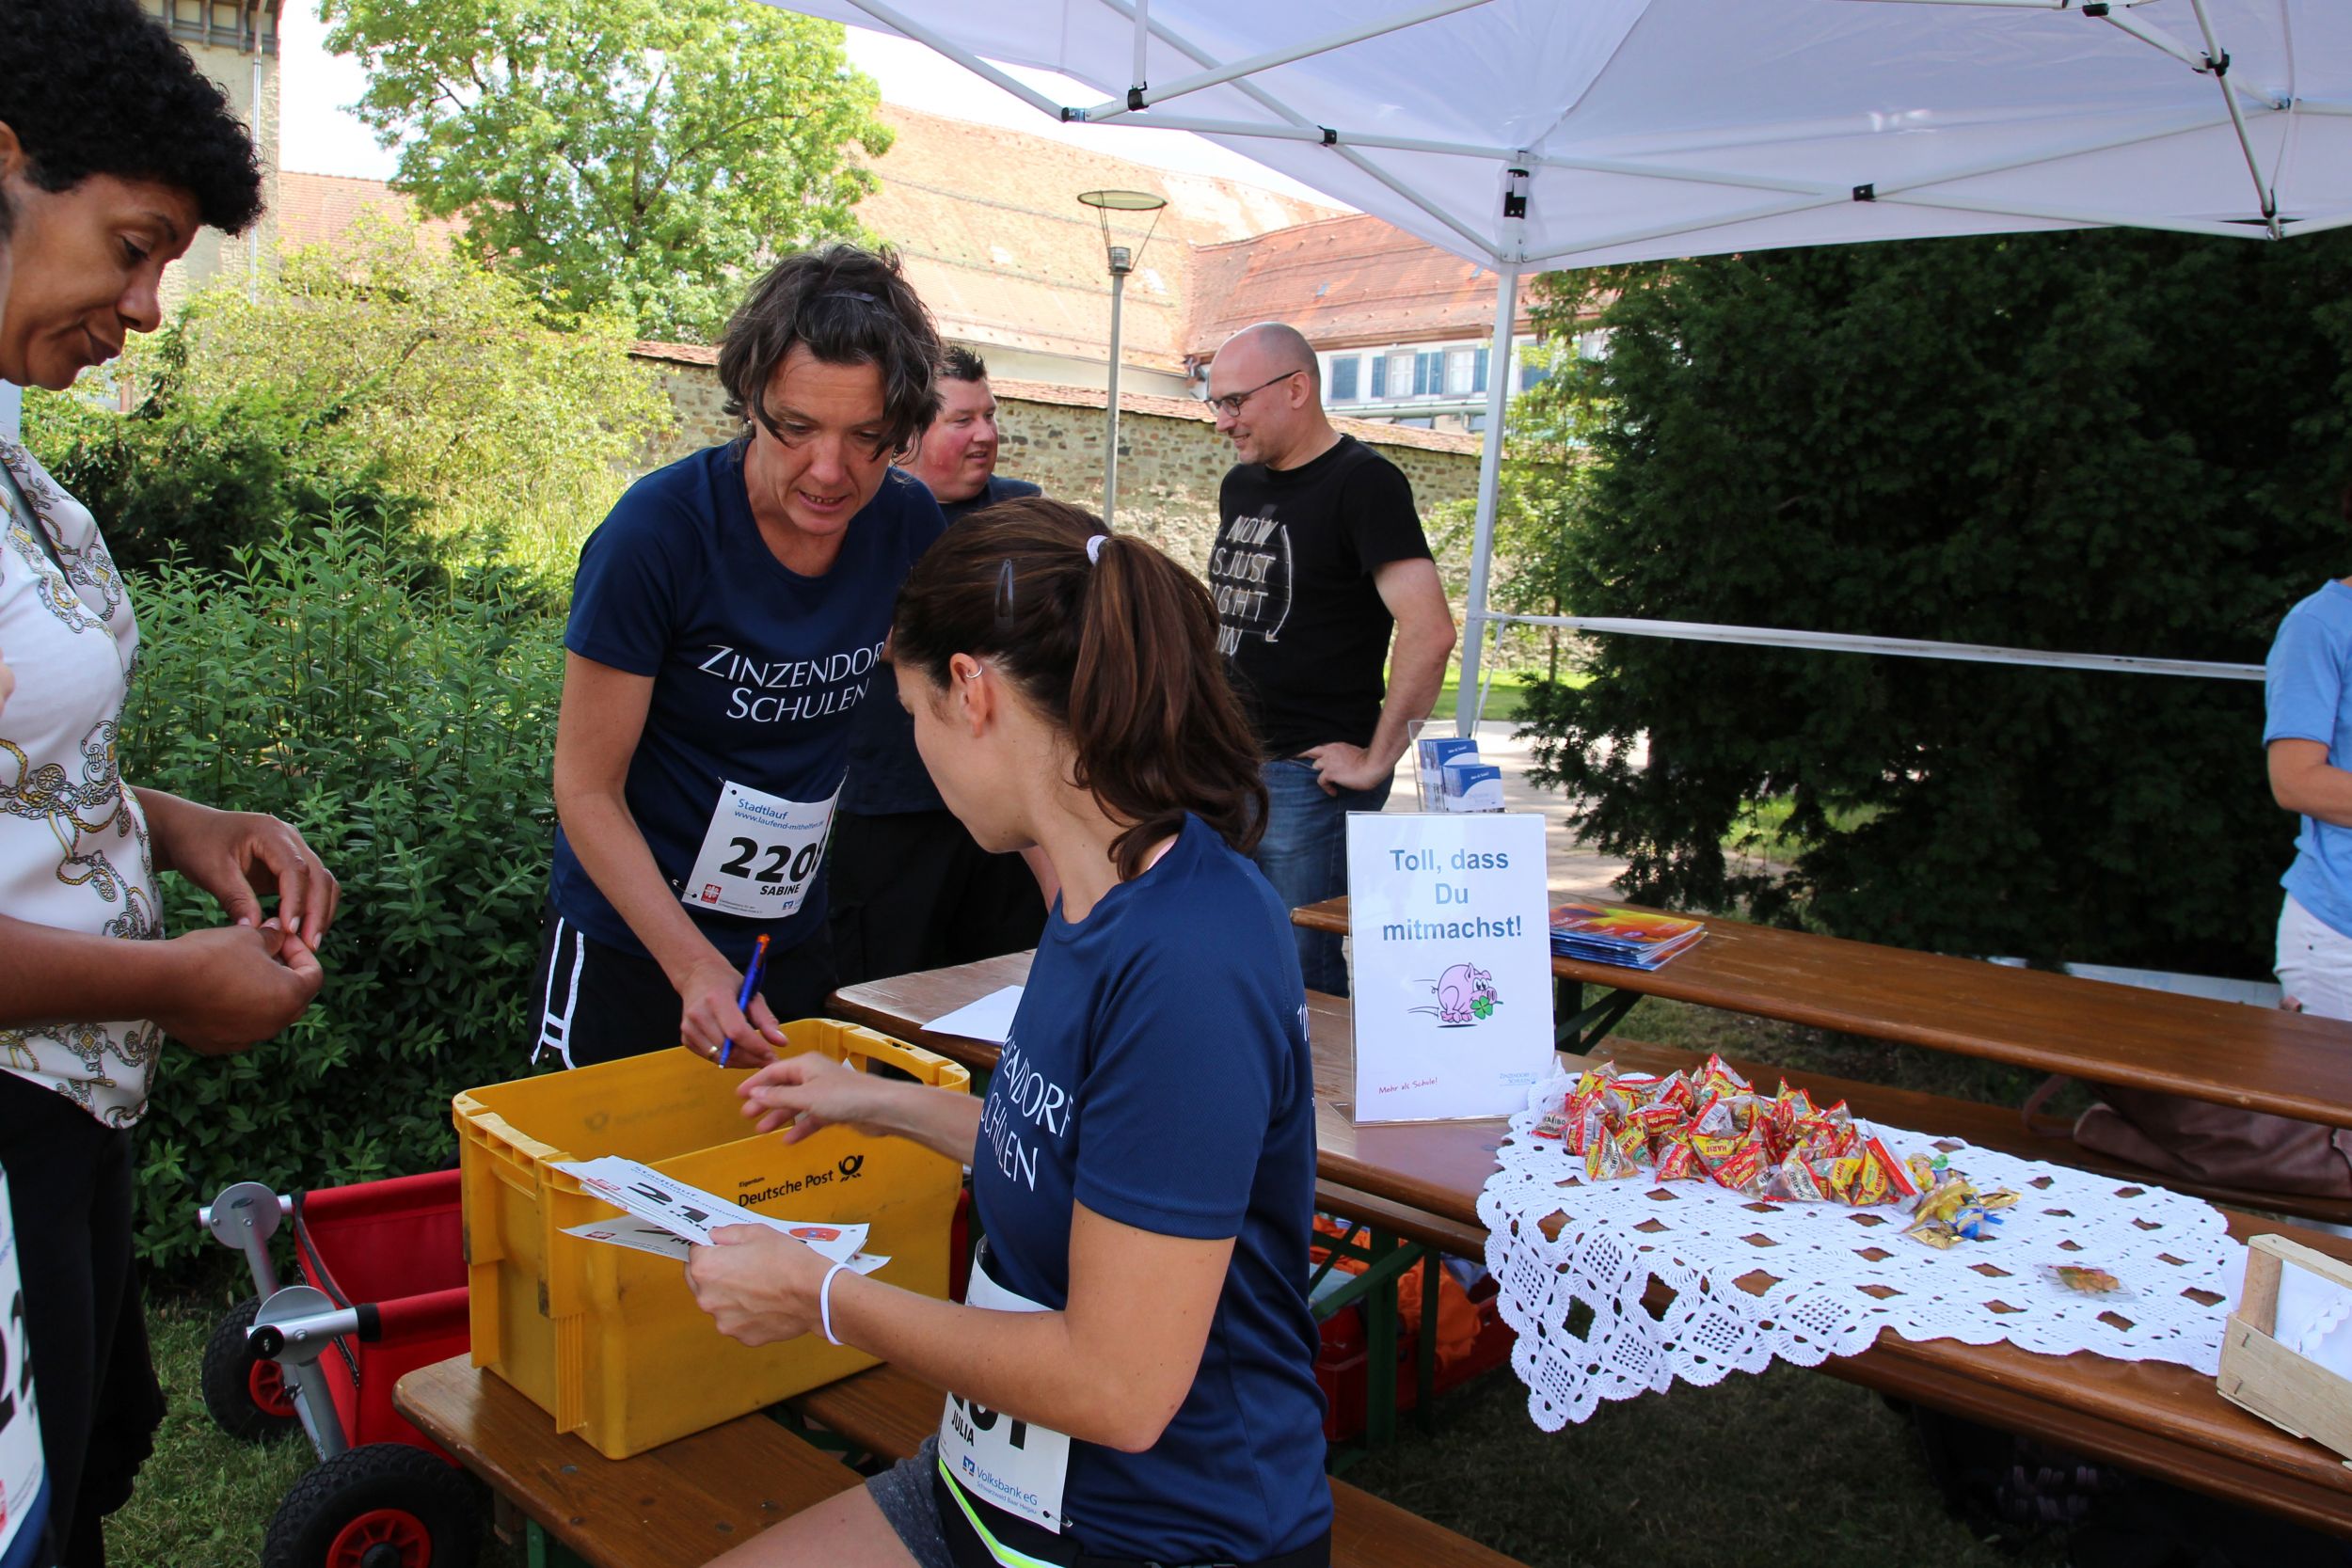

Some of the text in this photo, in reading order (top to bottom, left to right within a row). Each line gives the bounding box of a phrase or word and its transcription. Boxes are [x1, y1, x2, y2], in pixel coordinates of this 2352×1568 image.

[1226, 515, 1279, 546] NOW
[1212, 547, 1276, 584] S JUST
[1211, 581, 1269, 623] IGHT
[698, 641, 885, 688] ZINZENDOR
[725, 677, 869, 722] SCHULEN
[738, 798, 788, 820] Stadtlauf
[1389, 848, 1509, 875] Toll, dass
[759, 883, 801, 895] SABINE
[1435, 882, 1469, 905] Du
[1383, 915, 1521, 941] mitmachst!
[1378, 1085, 1398, 1095] Mehr
[1411, 1076, 1438, 1088] Schule!
[739, 1177, 765, 1187] Eigentum
[739, 1180, 802, 1208] Deutsche
[805, 1170, 834, 1188] Post
[951, 1410, 974, 1447] JULIA
[977, 1465, 1038, 1506] Volksbank eG
